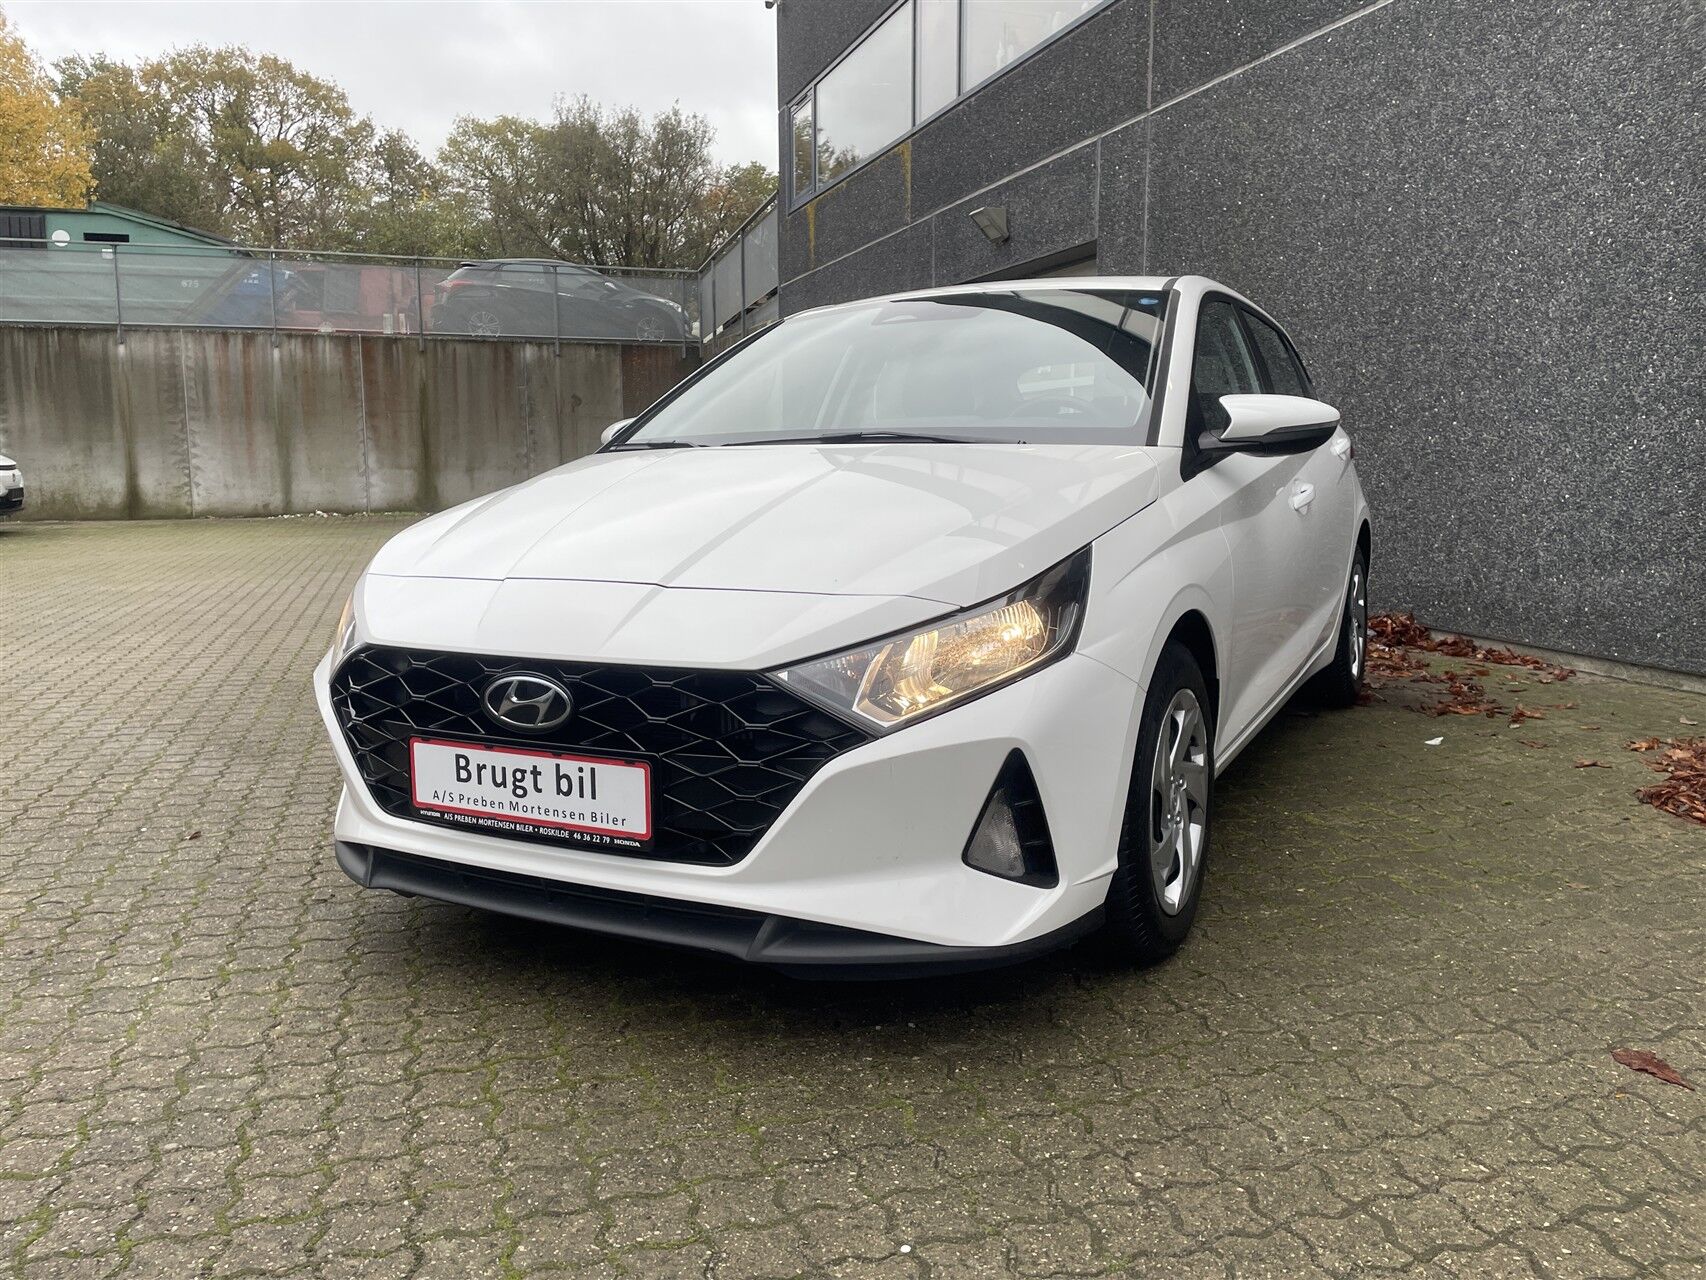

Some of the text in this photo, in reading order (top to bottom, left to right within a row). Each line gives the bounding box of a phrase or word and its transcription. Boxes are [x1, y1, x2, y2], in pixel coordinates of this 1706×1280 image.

[455, 753, 597, 800] Brugt bil
[433, 790, 627, 827] A/S Preben Mortensen Biler
[444, 813, 610, 844] A/S PREBEN MORTENSEN BILER ROSKILDE 46 36 22 79
[614, 839, 641, 847] HONDA
